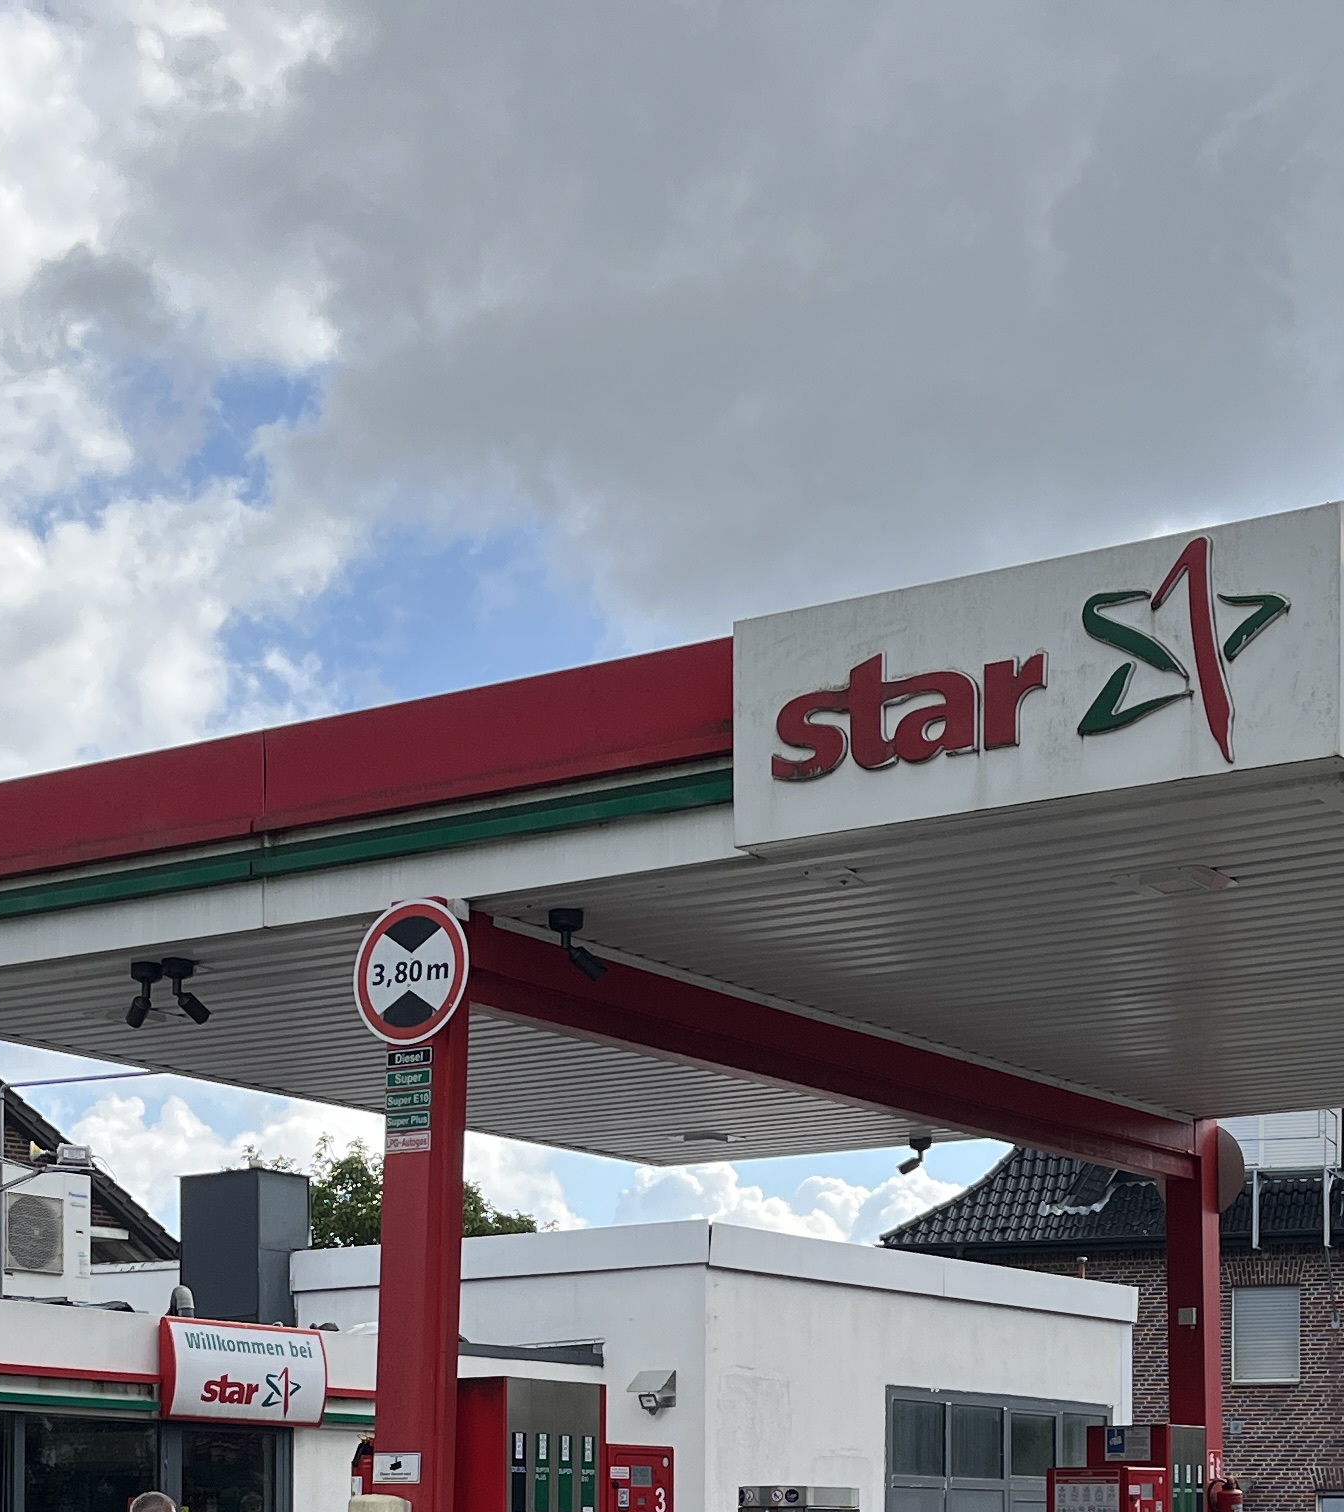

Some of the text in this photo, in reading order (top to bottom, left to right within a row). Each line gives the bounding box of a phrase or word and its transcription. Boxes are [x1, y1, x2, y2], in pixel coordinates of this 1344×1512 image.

[772, 650, 1048, 781] star
[372, 959, 449, 988] 3,80 m
[394, 1051, 424, 1064] Diesel
[394, 1073, 423, 1085] Super
[387, 1093, 429, 1107] Super E10
[387, 1115, 427, 1128] Super Plus
[185, 1332, 313, 1359] Willkommen bei
[201, 1374, 259, 1405] star
